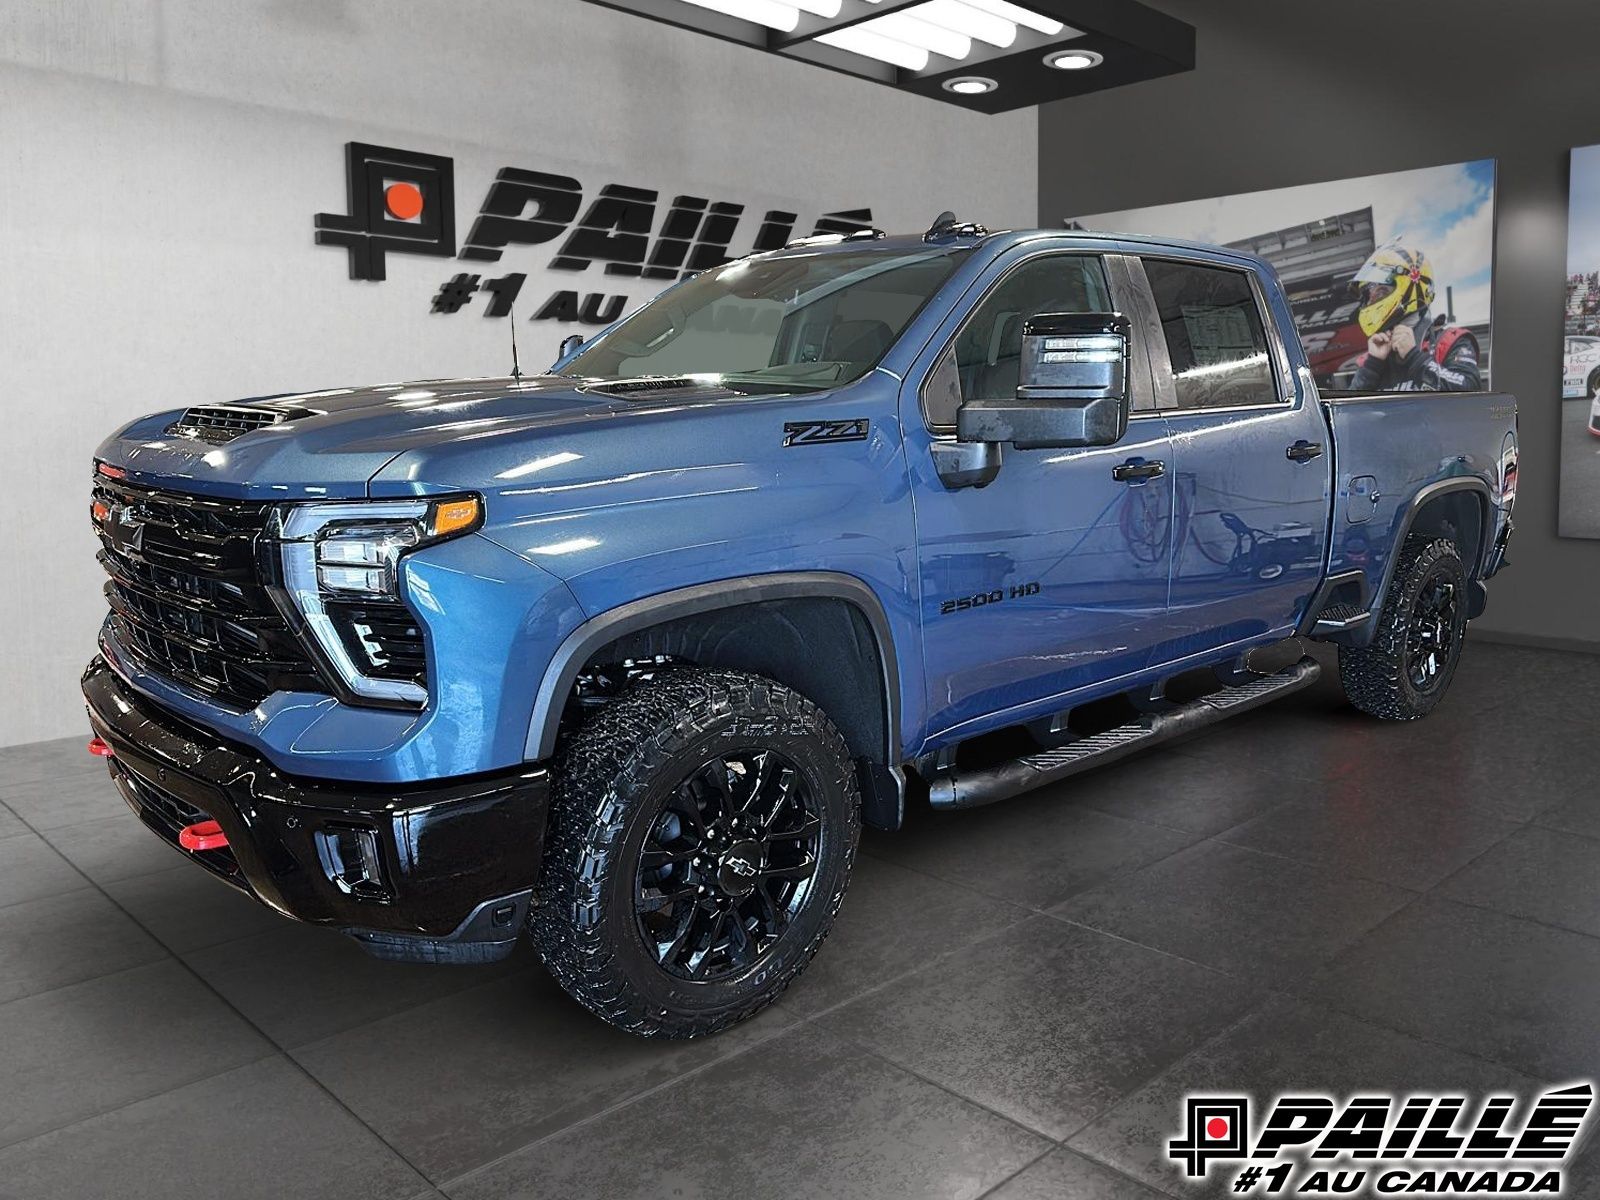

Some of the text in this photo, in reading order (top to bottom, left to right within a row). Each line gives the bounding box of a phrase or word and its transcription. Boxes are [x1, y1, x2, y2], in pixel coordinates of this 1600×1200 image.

[430, 273, 629, 325] #1 AU
[940, 581, 1040, 615] 2500 HD
